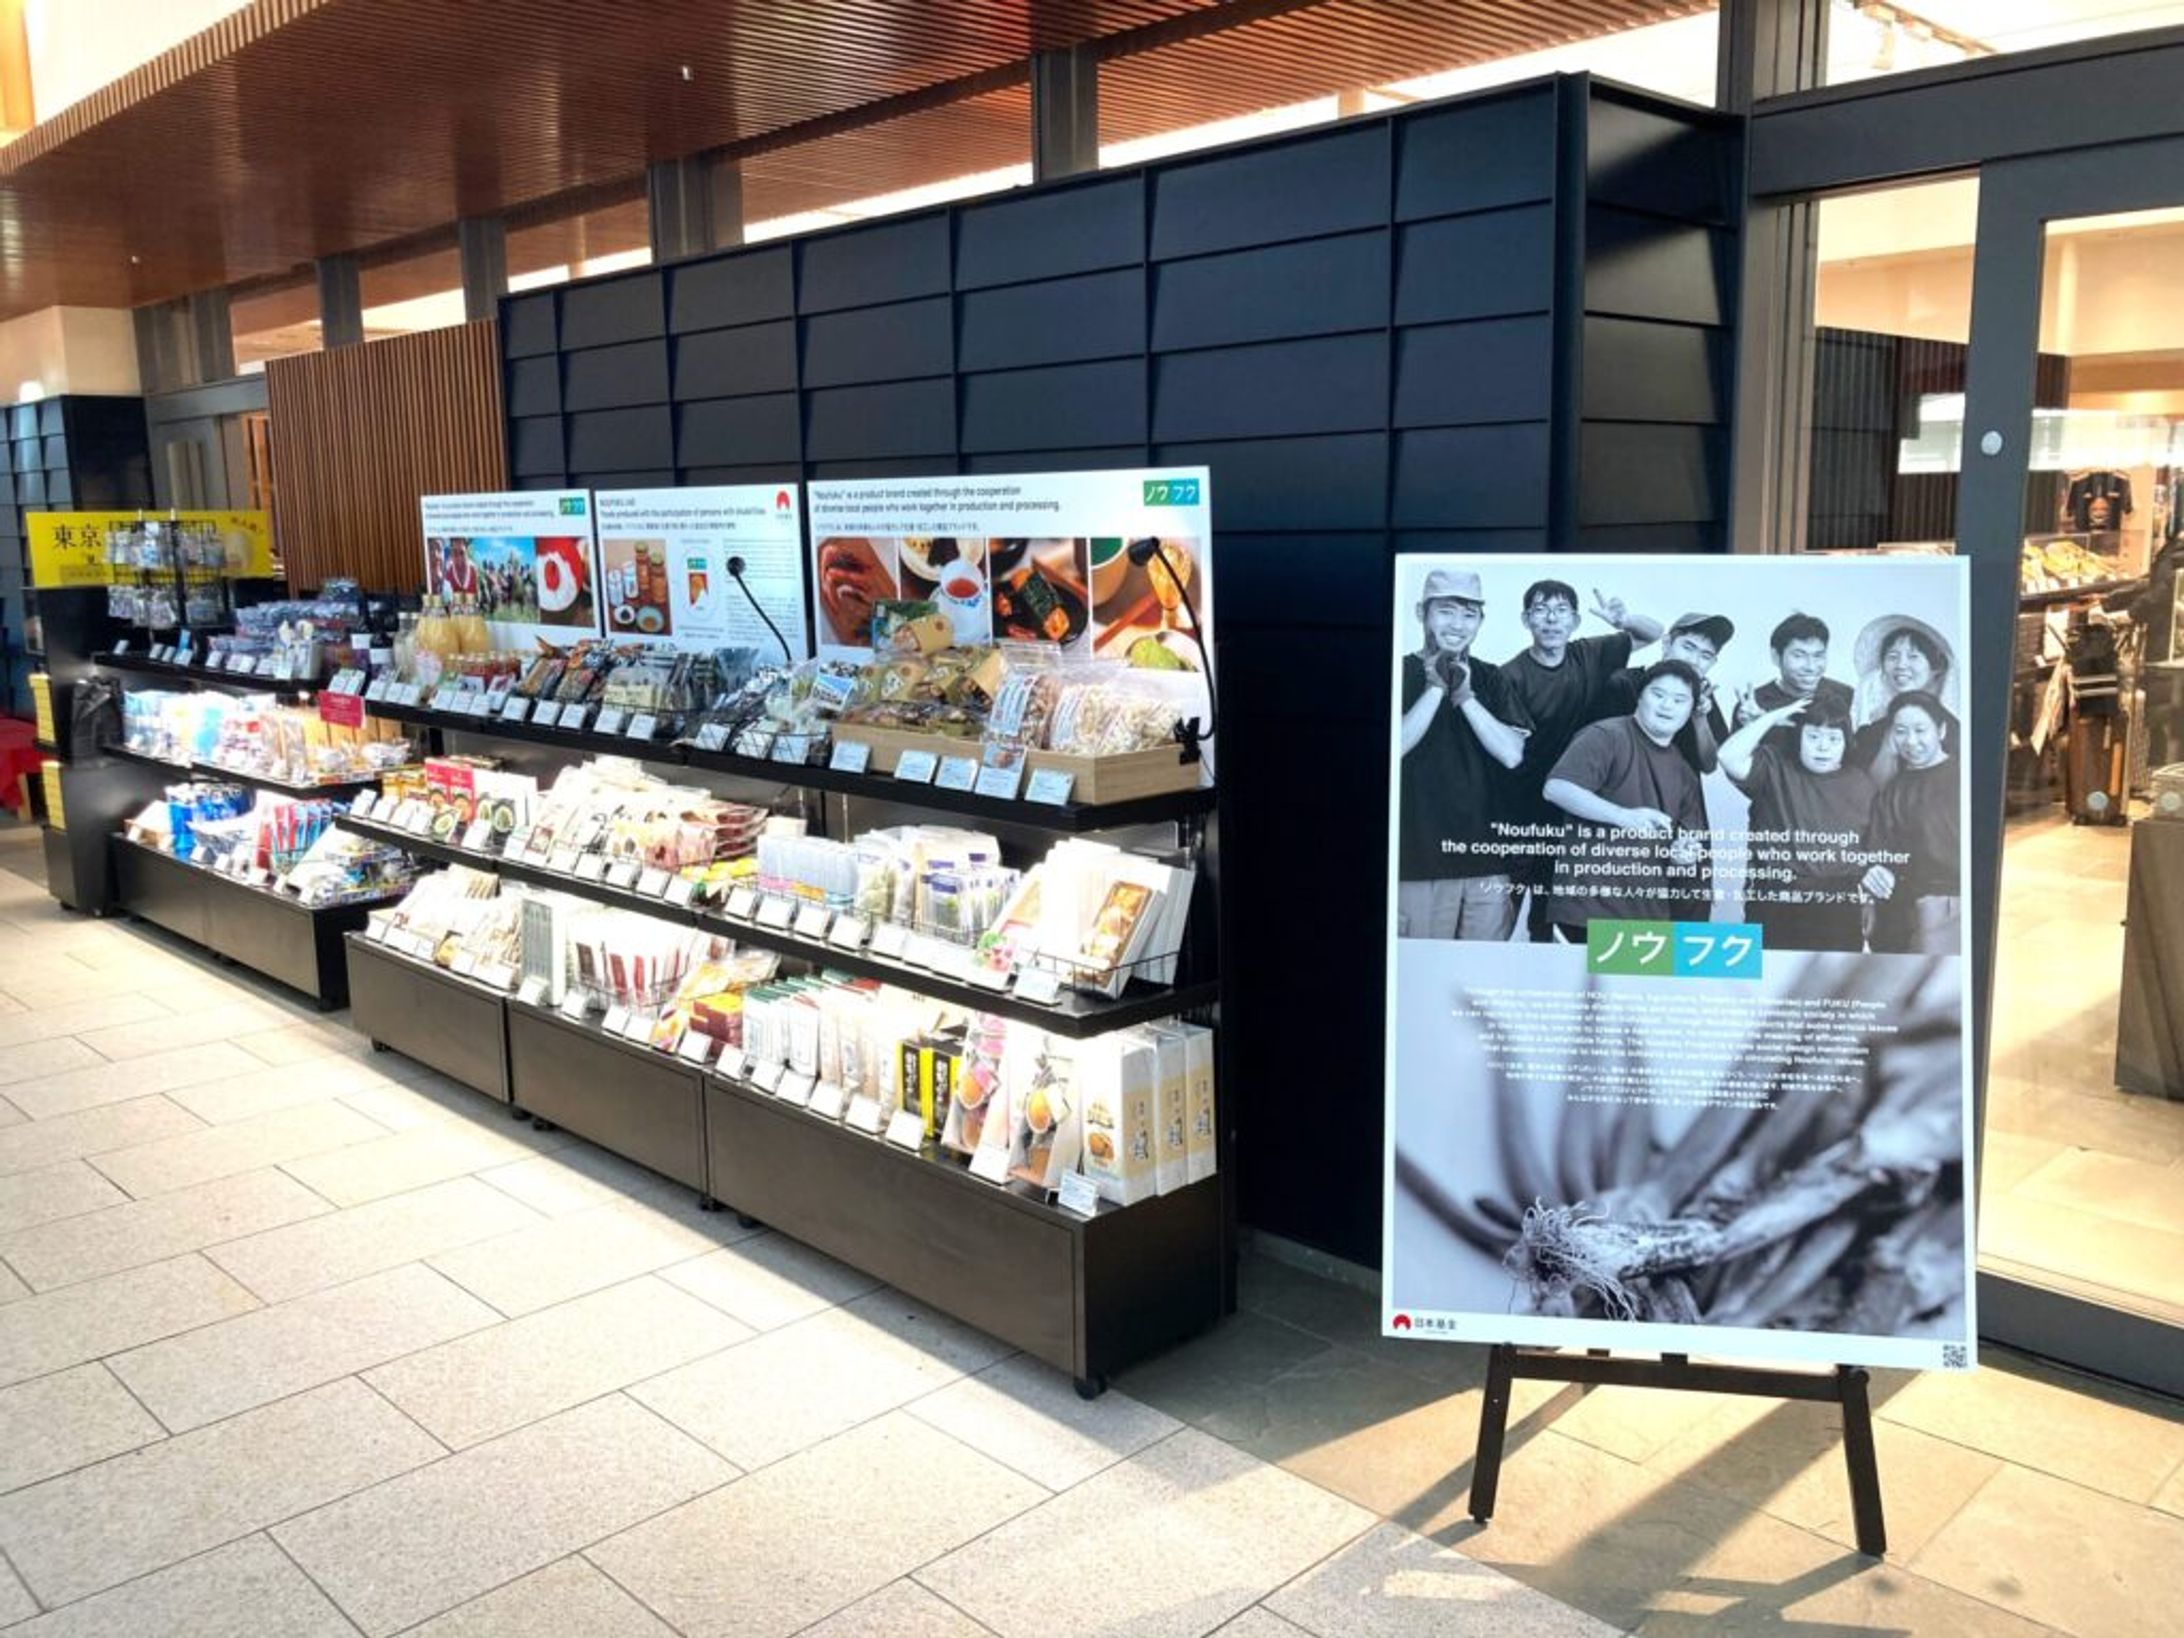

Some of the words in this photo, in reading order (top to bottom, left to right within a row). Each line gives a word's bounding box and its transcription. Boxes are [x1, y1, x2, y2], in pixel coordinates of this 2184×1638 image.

[1146, 484, 1196, 501] ノウフク
[1490, 822, 1574, 838] "Noufuku"
[1577, 824, 1592, 839] is
[1596, 826, 1606, 839] a
[1610, 825, 1673, 842] product
[1678, 828, 1725, 842] brand
[1728, 829, 1791, 844] created
[1795, 829, 1860, 847] through
[1441, 839, 1467, 853] the
[1470, 841, 1567, 858] cooperation
[1570, 842, 1587, 857] of
[1590, 843, 1651, 858] diverse
[1655, 845, 1696, 860] local
[1698, 846, 1753, 863] people
[1757, 848, 1791, 862] who
[1796, 848, 1837, 863] work
[1841, 849, 1911, 867] together
[1554, 861, 1569, 874] in
[1573, 861, 1663, 878] production
[1666, 863, 1697, 878] and
[1701, 866, 1798, 884] processing.
[1596, 930, 1753, 968] ノウフク
